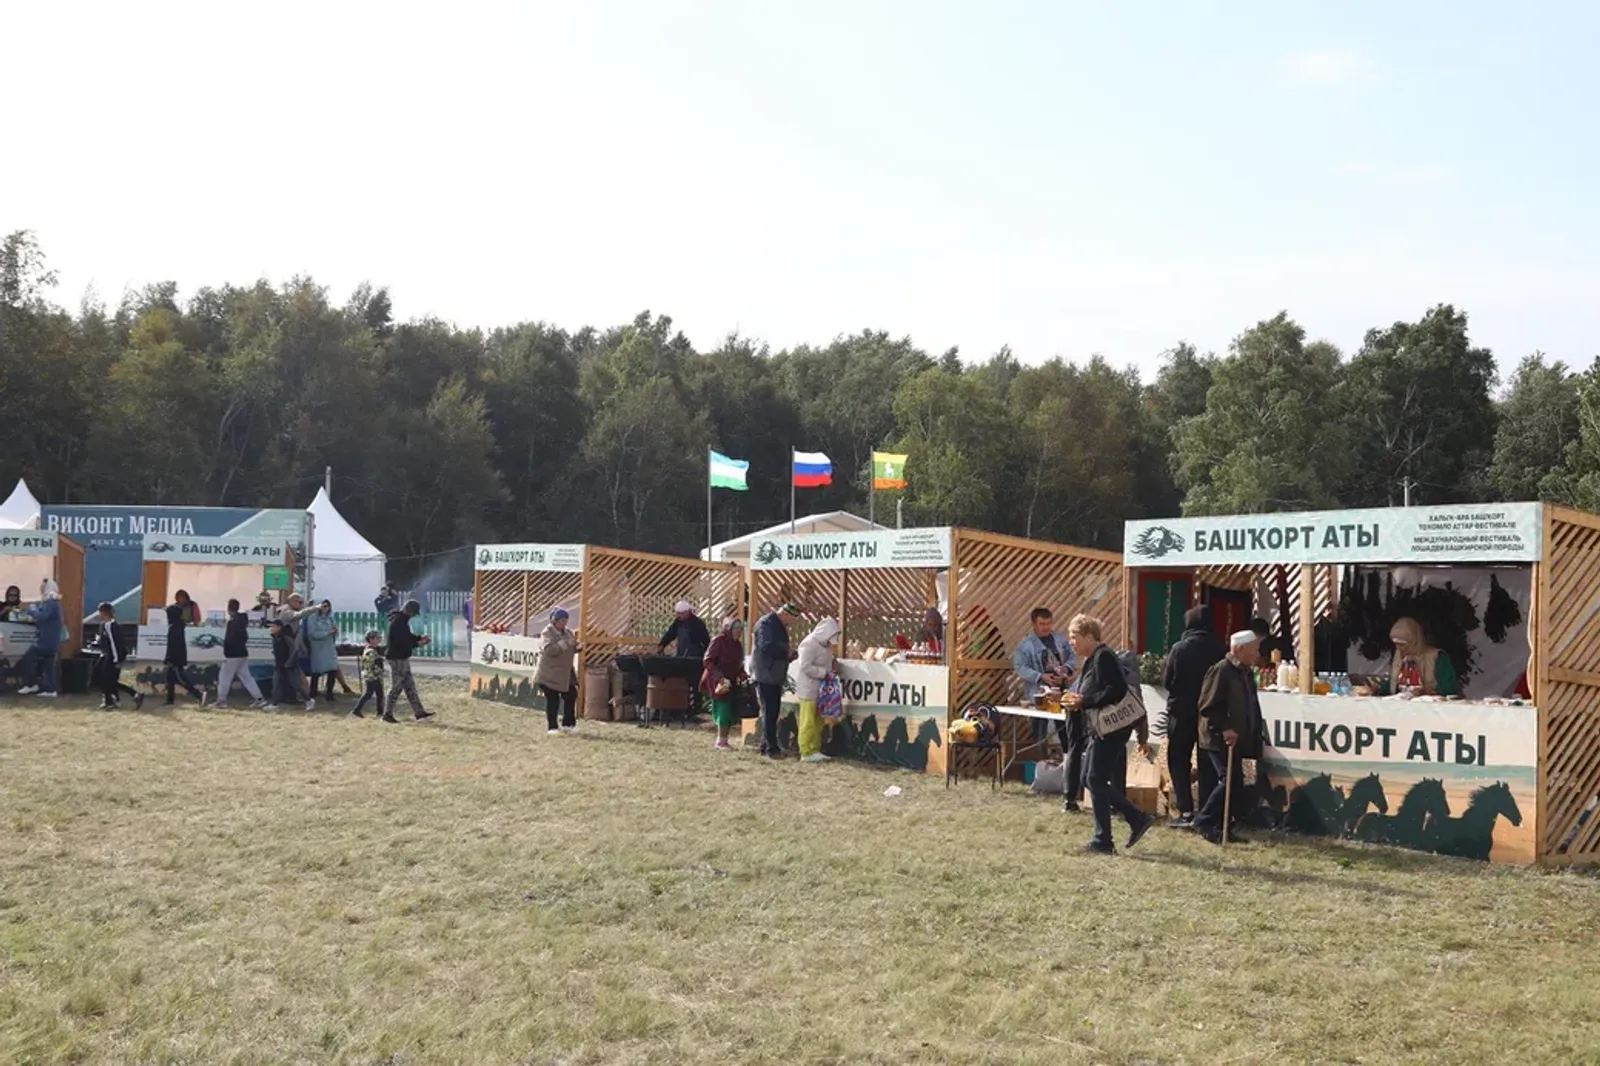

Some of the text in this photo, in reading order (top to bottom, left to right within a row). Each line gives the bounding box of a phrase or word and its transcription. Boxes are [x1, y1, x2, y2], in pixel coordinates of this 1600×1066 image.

[48, 514, 195, 535] ВИКОНТ МЕДИА
[23, 537, 53, 548] АТЫ
[1195, 523, 1380, 552] БАШҠОРТ АТЫ
[1413, 534, 1521, 543] МЕЖДУНАРОДНЫЙ ФЕСТИВАЛЬ
[251, 546, 281, 557] АТЫ
[849, 541, 878, 558] АТЫ
[840, 678, 926, 708] ҠОРТ АТЫ
[1405, 730, 1487, 767] АТЫ
